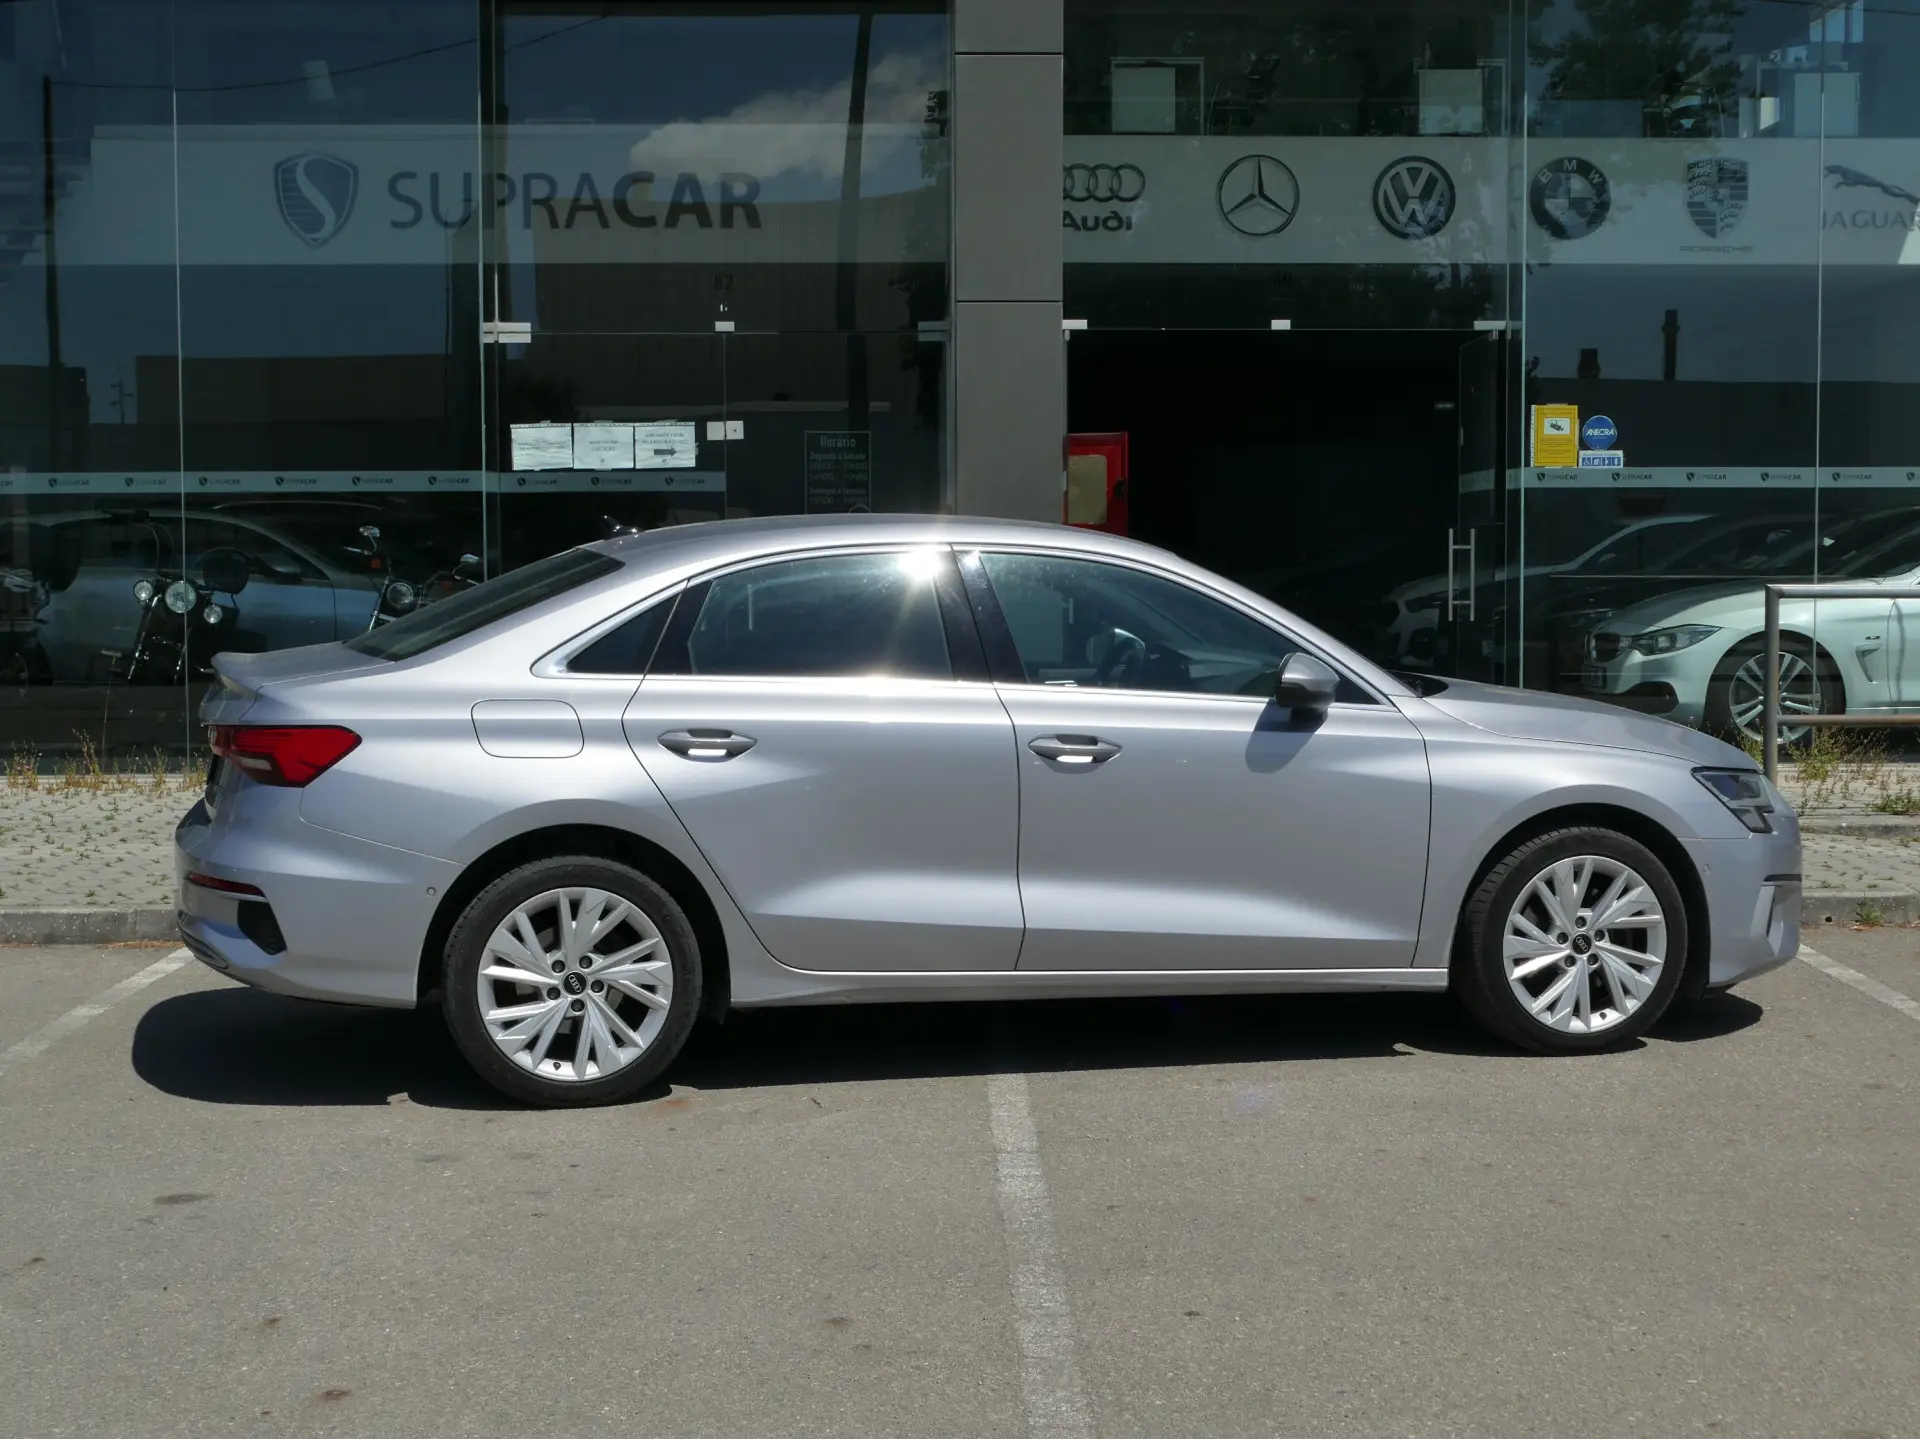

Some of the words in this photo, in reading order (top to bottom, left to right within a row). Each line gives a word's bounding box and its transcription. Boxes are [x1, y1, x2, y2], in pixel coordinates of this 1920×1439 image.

[1539, 159, 1604, 186] BMW
[387, 170, 762, 230] SUPRACAR
[1063, 209, 1133, 232] Audi
[1679, 244, 1754, 253] PORSCHE
[1585, 428, 1614, 436] ANECRA
[820, 435, 856, 448] Horário
